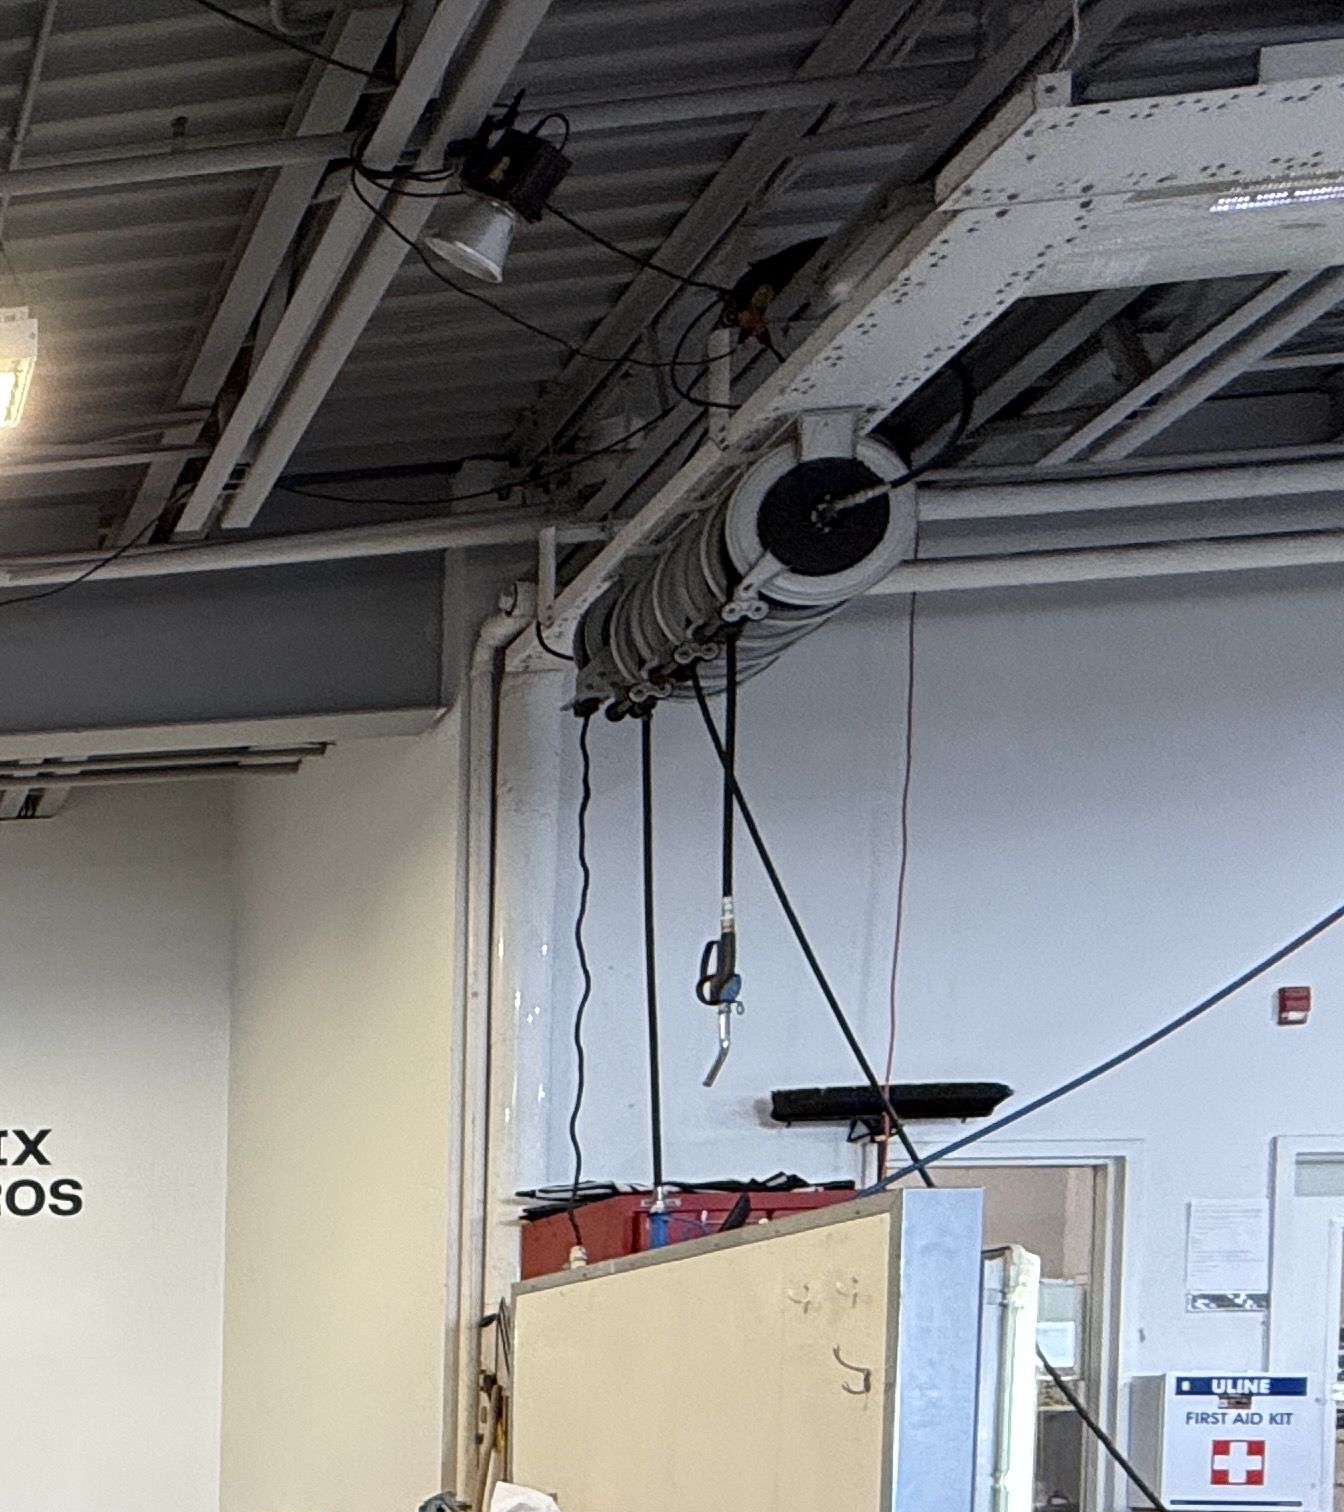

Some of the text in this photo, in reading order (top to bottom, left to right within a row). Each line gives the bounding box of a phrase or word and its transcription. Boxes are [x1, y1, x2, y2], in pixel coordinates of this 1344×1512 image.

[1212, 1379, 1271, 1394] ULINE
[1185, 1411, 1294, 1425] FIRST AID KIT
